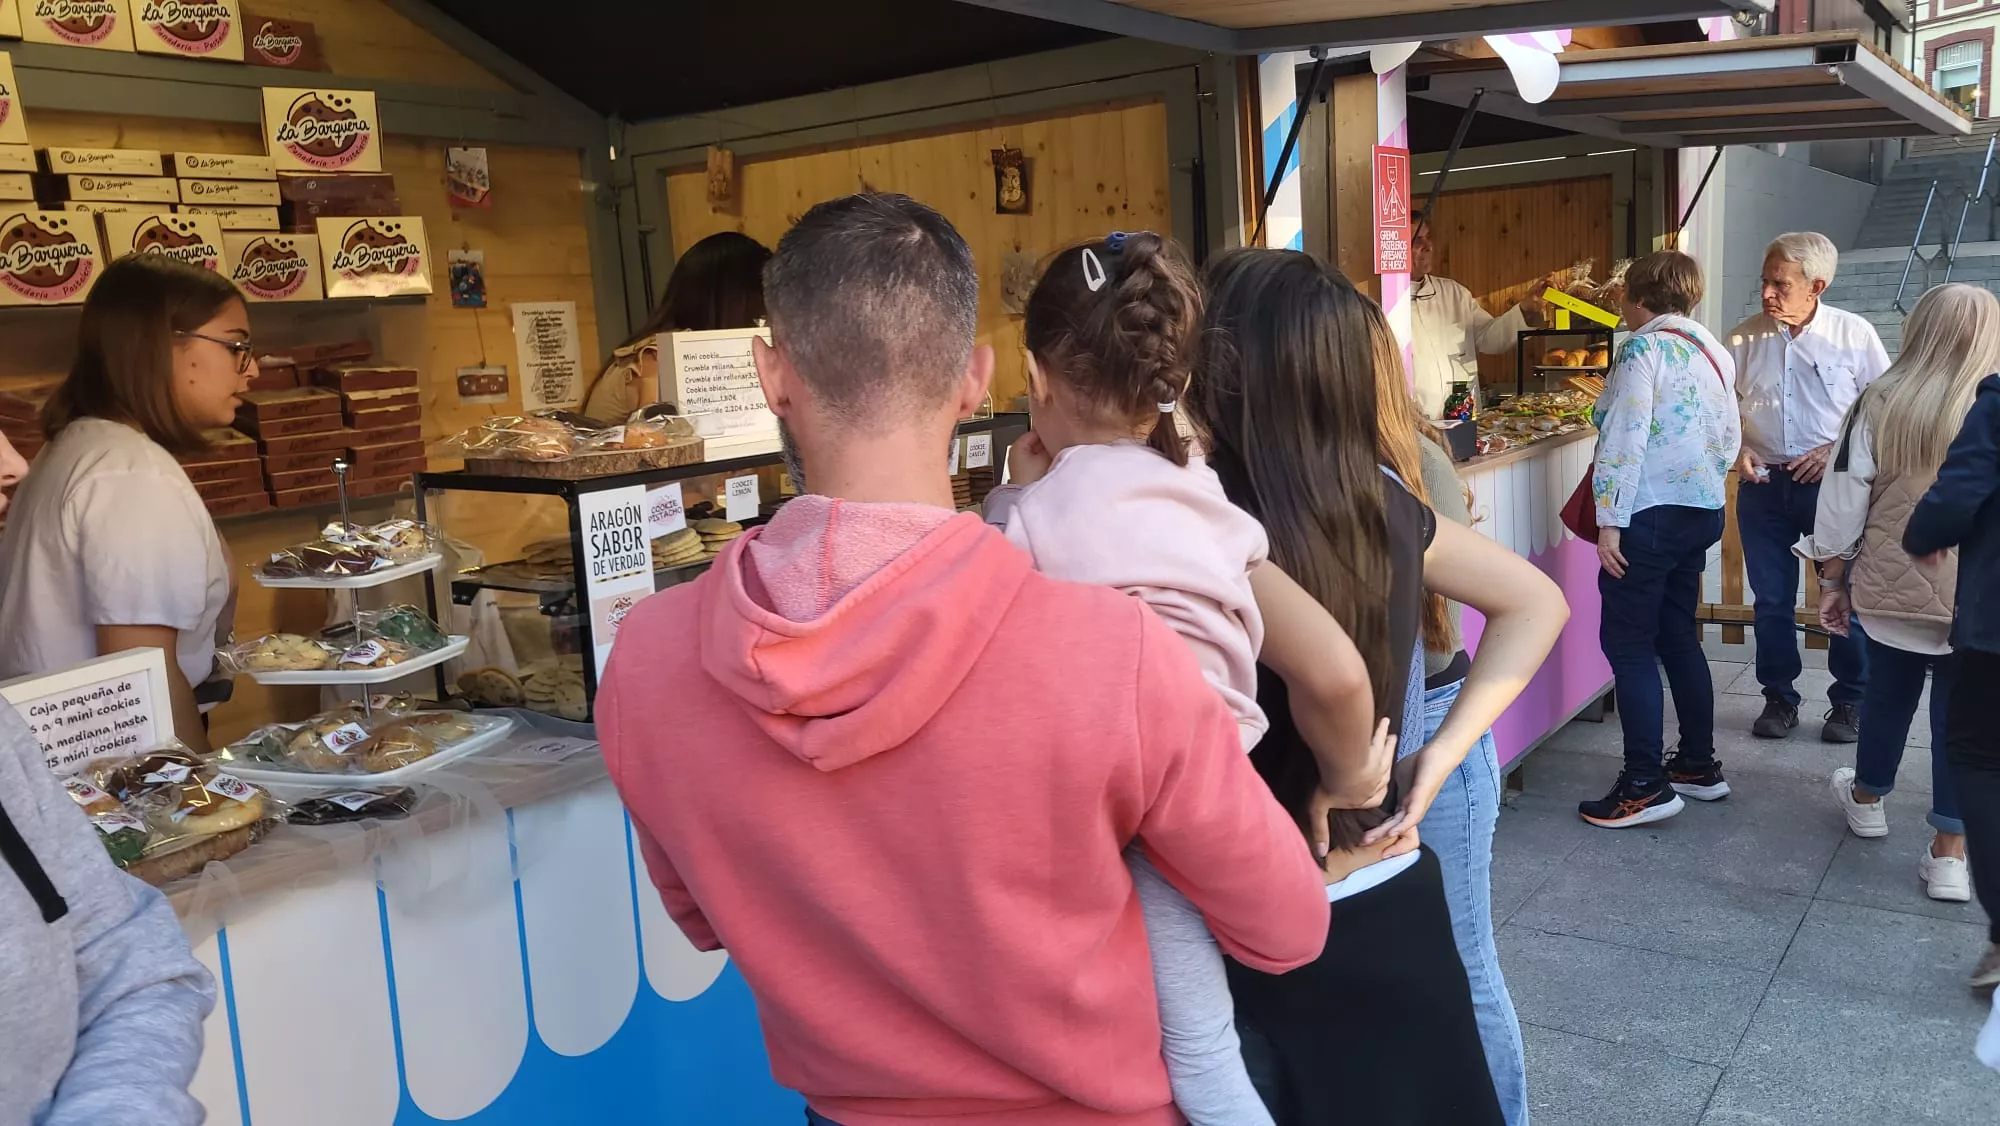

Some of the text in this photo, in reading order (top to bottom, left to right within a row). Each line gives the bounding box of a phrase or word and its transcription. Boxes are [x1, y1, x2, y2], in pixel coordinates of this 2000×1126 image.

[35, 0, 116, 22] La Barquera
[142, 1, 230, 27] La Barquera
[276, 119, 370, 145] La Barquera
[0, 243, 93, 273] a Barquera
[233, 257, 308, 280] La Barquera
[332, 250, 353, 269] La
[353, 244, 420, 271] Barquera
[1381, 260, 1389, 270] DE
[684, 363, 710, 372] Crumble
[685, 375, 710, 384] Crumble
[686, 386, 707, 394] Cookie
[591, 501, 642, 532] ARAGÓN
[648, 507, 682, 522] PISTACHO
[651, 500, 678, 514] COOKIE
[591, 526, 644, 558] SABOR
[593, 552, 646, 576] DE VERDAD
[30, 682, 131, 716] Caja pequeña de
[54, 716, 63, 726] 9
[67, 708, 93, 725] mini
[97, 697, 141, 716] cookies
[57, 726, 110, 748] mediana
[114, 715, 148, 731] hasta
[45, 735, 137, 769] 15 mini cookies
